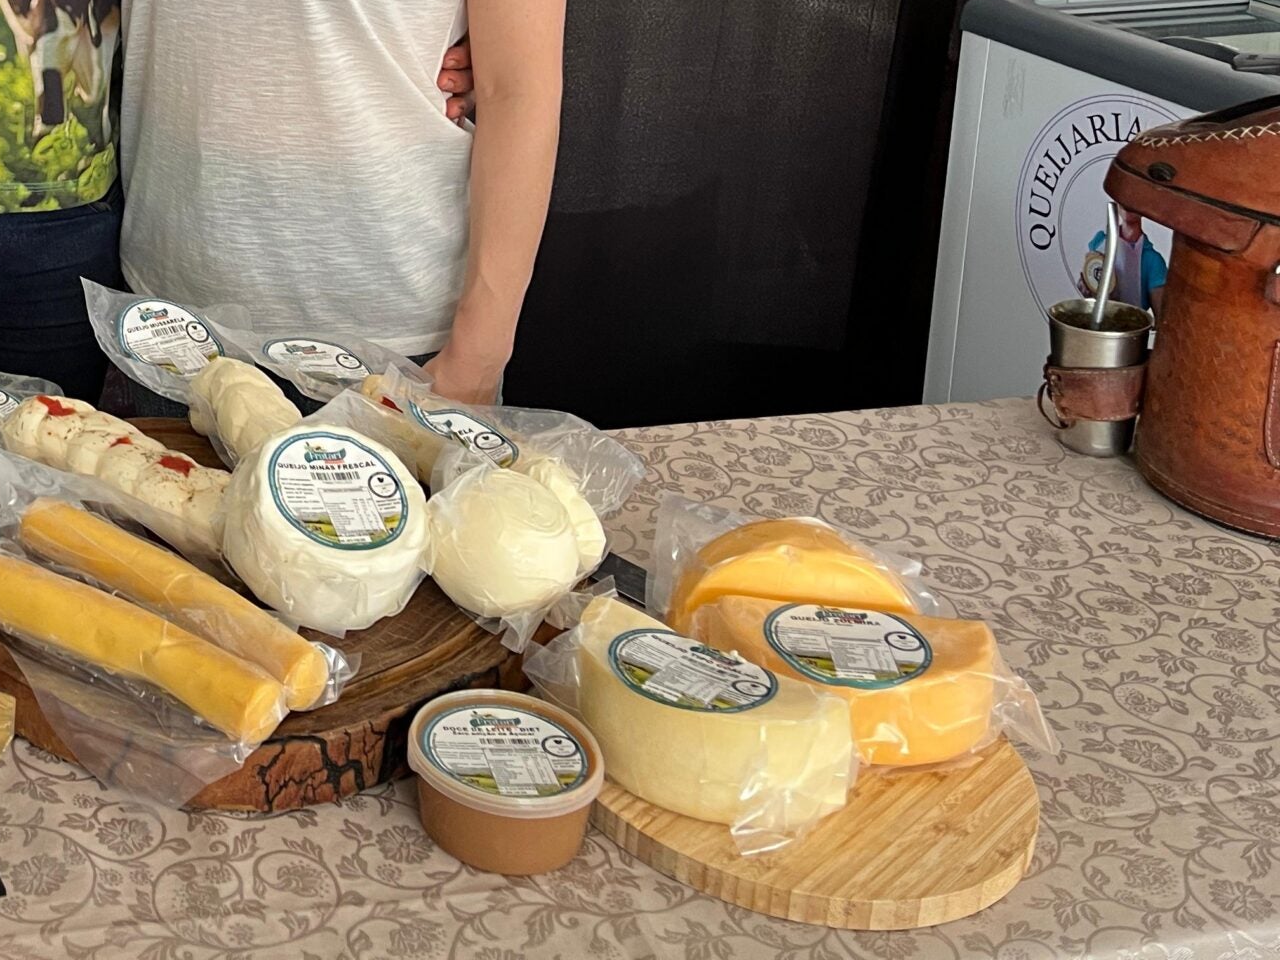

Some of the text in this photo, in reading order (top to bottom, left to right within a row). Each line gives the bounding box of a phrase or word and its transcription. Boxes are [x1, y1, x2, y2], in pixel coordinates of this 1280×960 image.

[1028, 112, 1142, 251] QUEIJARIA
[277, 462, 307, 470] QUEIJO
[337, 460, 376, 470] FRESCAL
